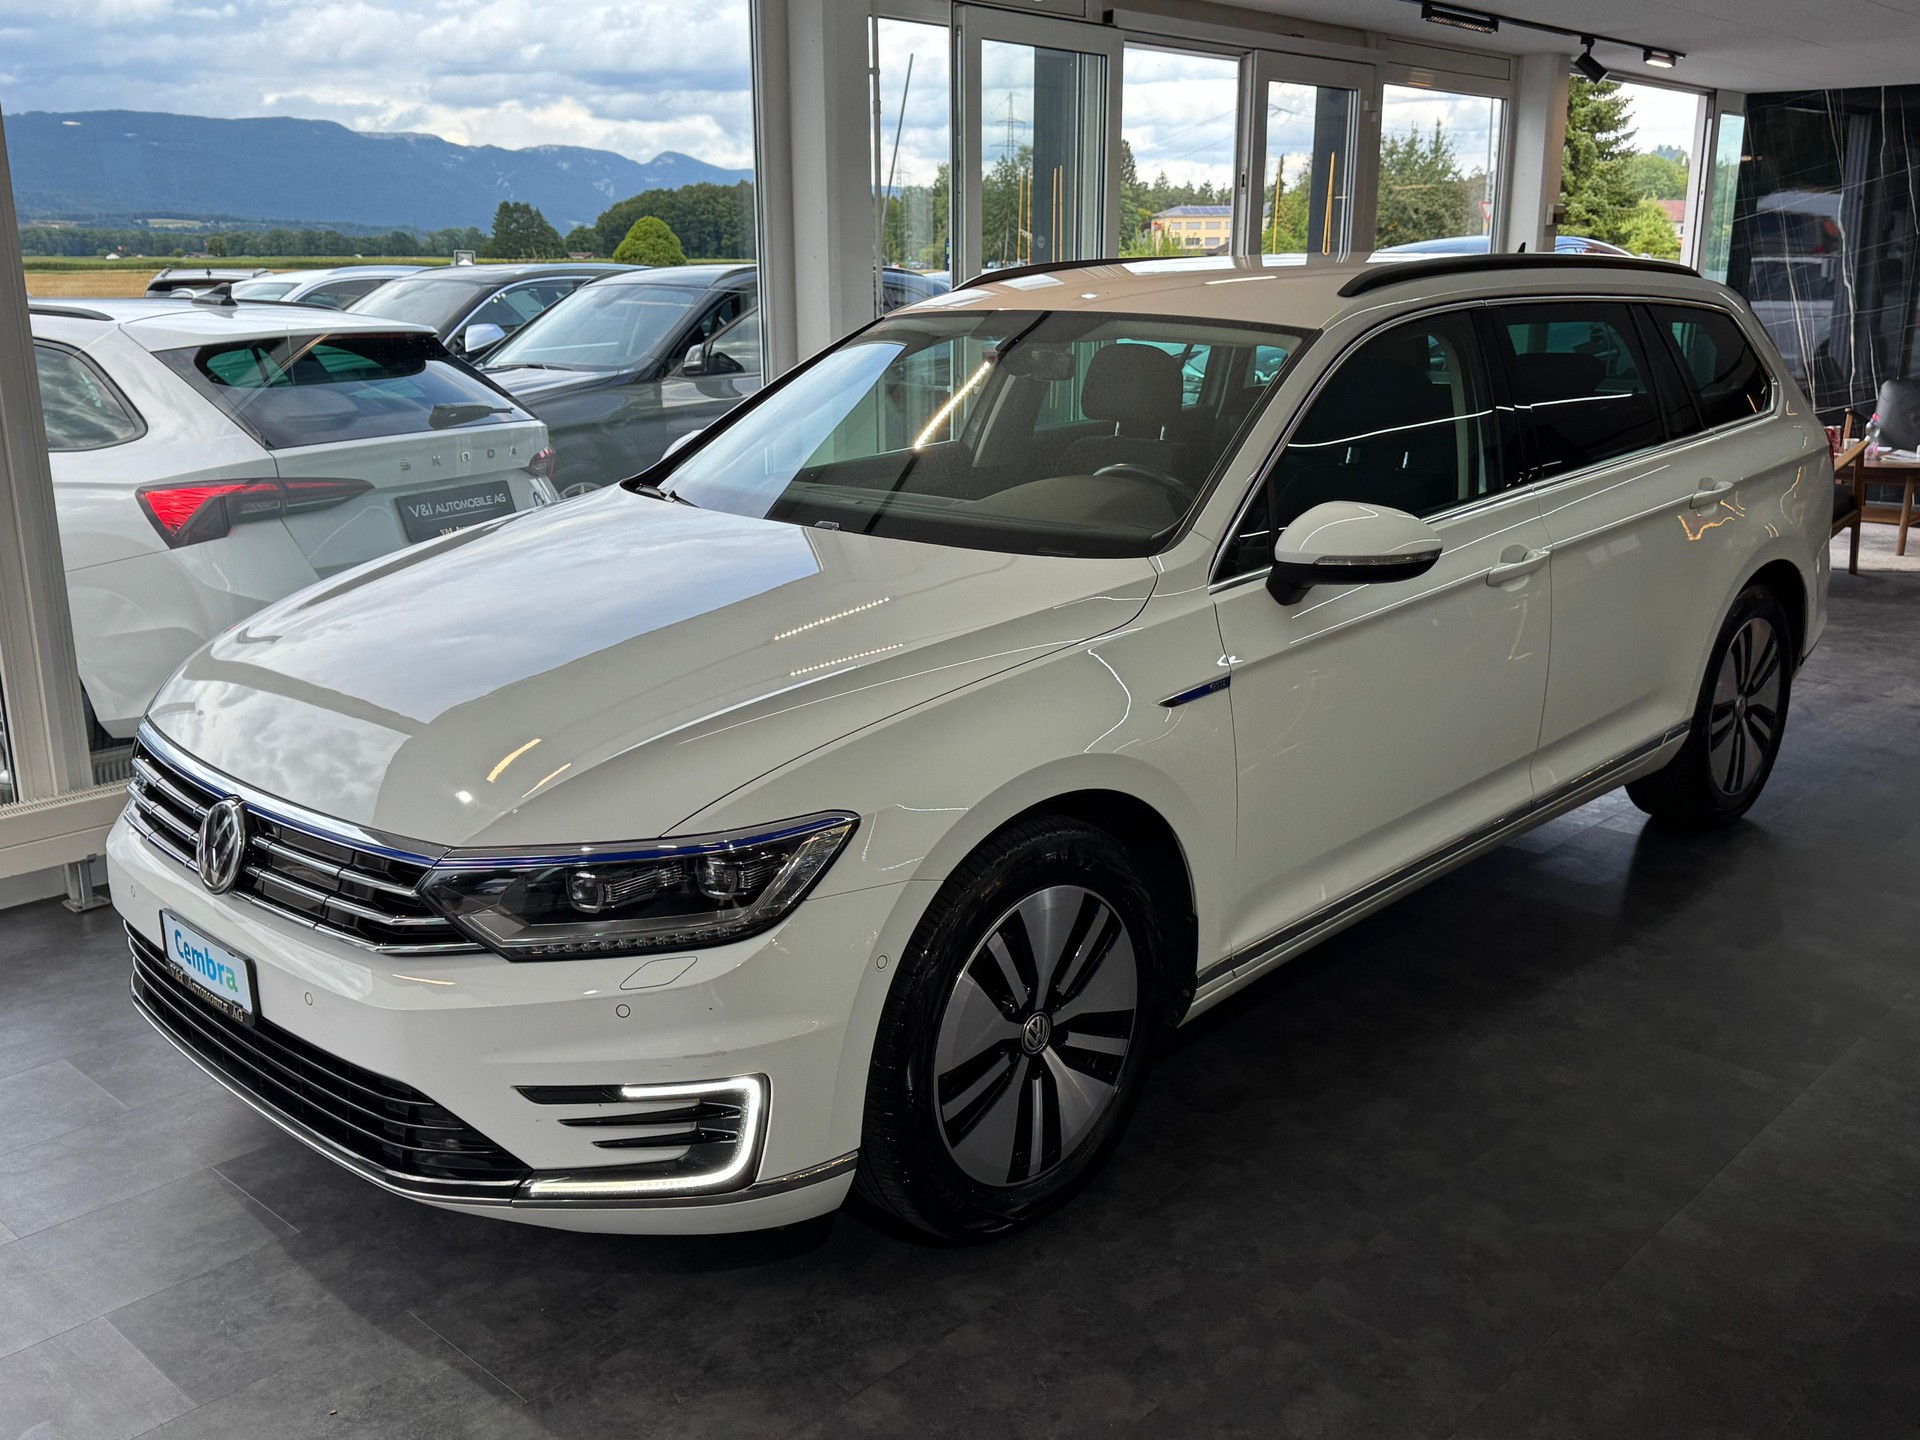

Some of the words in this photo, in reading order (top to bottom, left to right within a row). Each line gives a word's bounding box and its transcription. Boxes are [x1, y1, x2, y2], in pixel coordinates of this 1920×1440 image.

[408, 502, 433, 518] V&I
[435, 494, 494, 515] AUTOMOBILE
[494, 493, 506, 504] AG
[174, 929, 239, 993] Cembra
[187, 976, 229, 1014] AUTOMOBILE
[232, 1005, 244, 1022] AG
